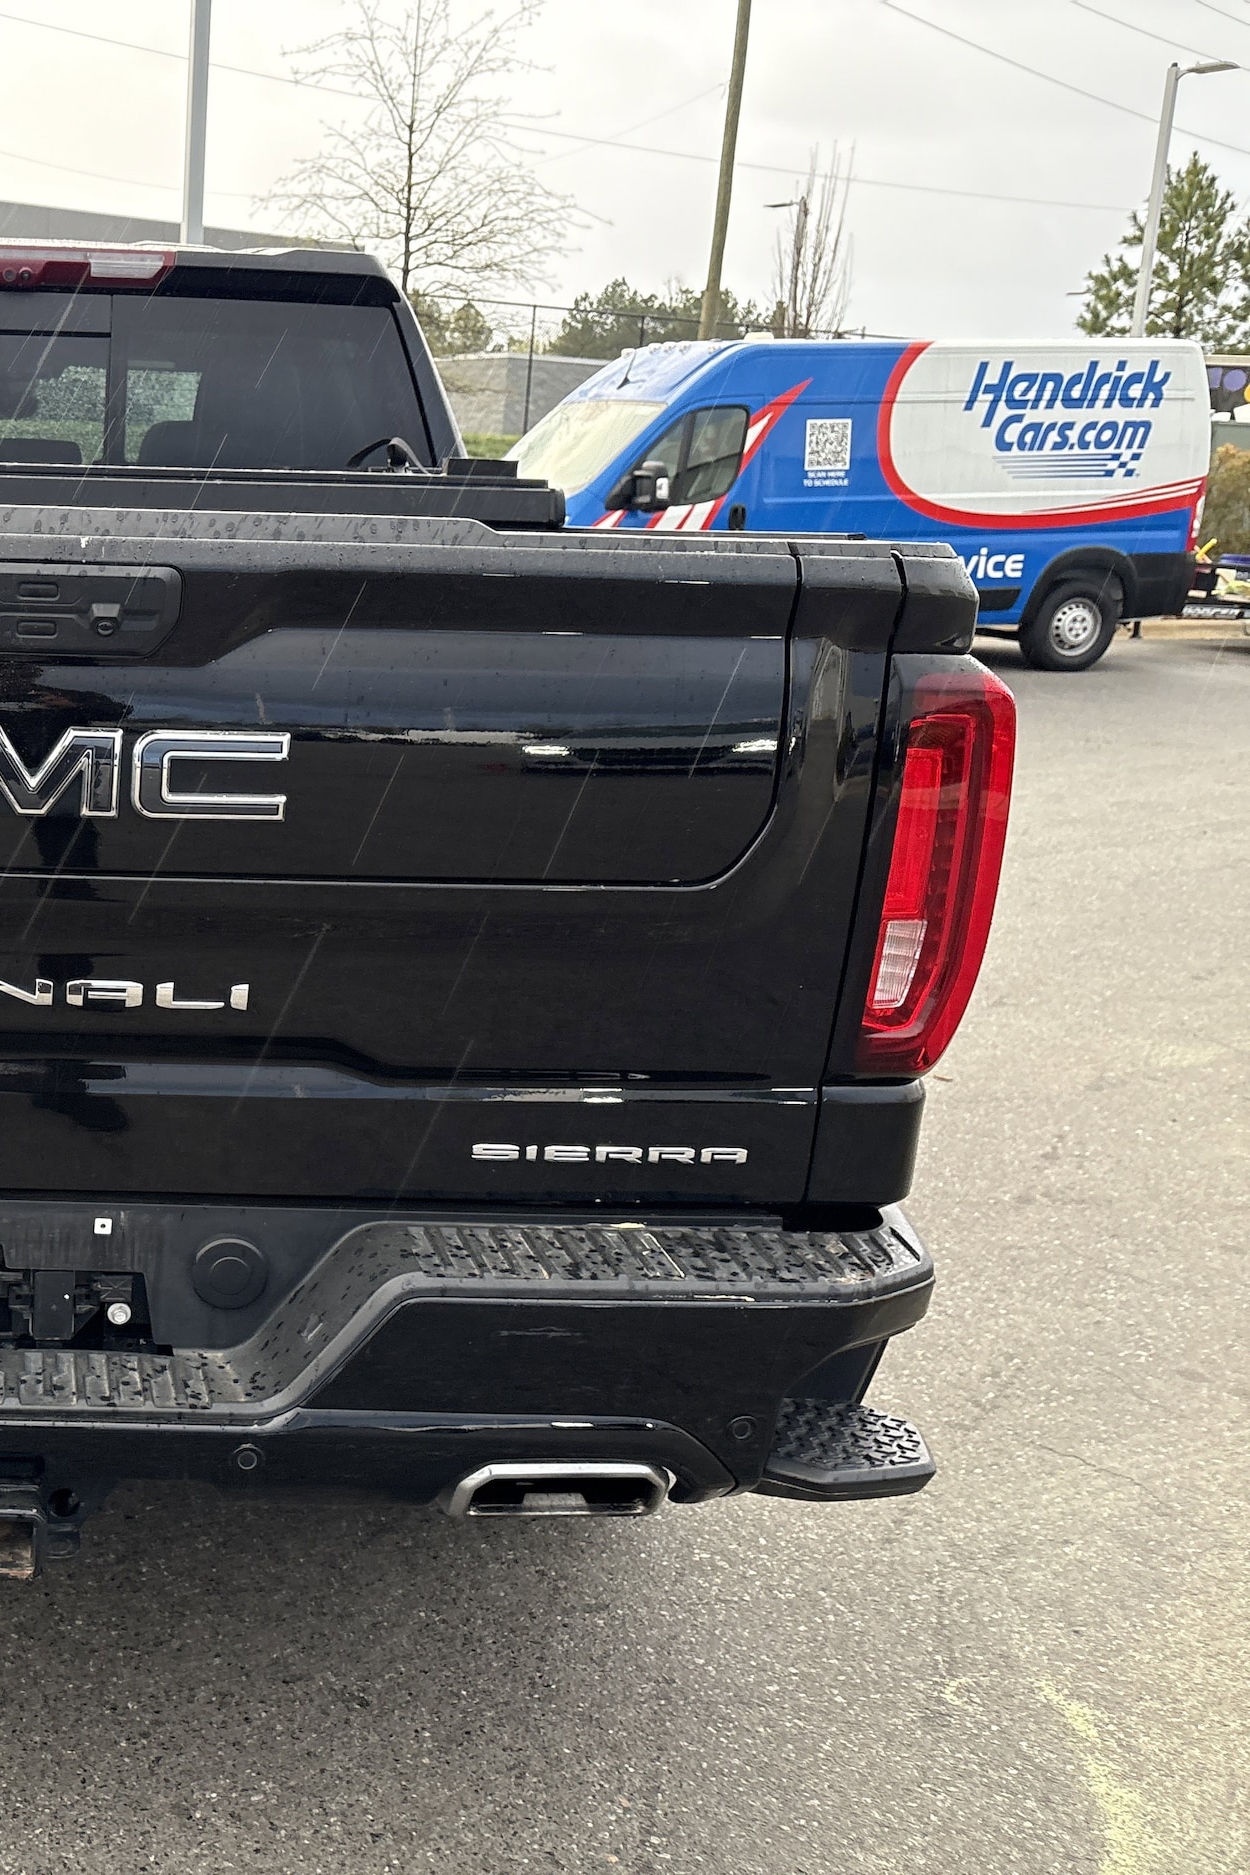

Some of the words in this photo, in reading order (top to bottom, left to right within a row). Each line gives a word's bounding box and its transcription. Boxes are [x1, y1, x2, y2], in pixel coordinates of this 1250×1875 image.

[963, 360, 1172, 428] Hendrick
[995, 413, 1153, 452] Cars.com
[803, 478, 813, 487] TO
[471, 1143, 748, 1164] SIERRA
